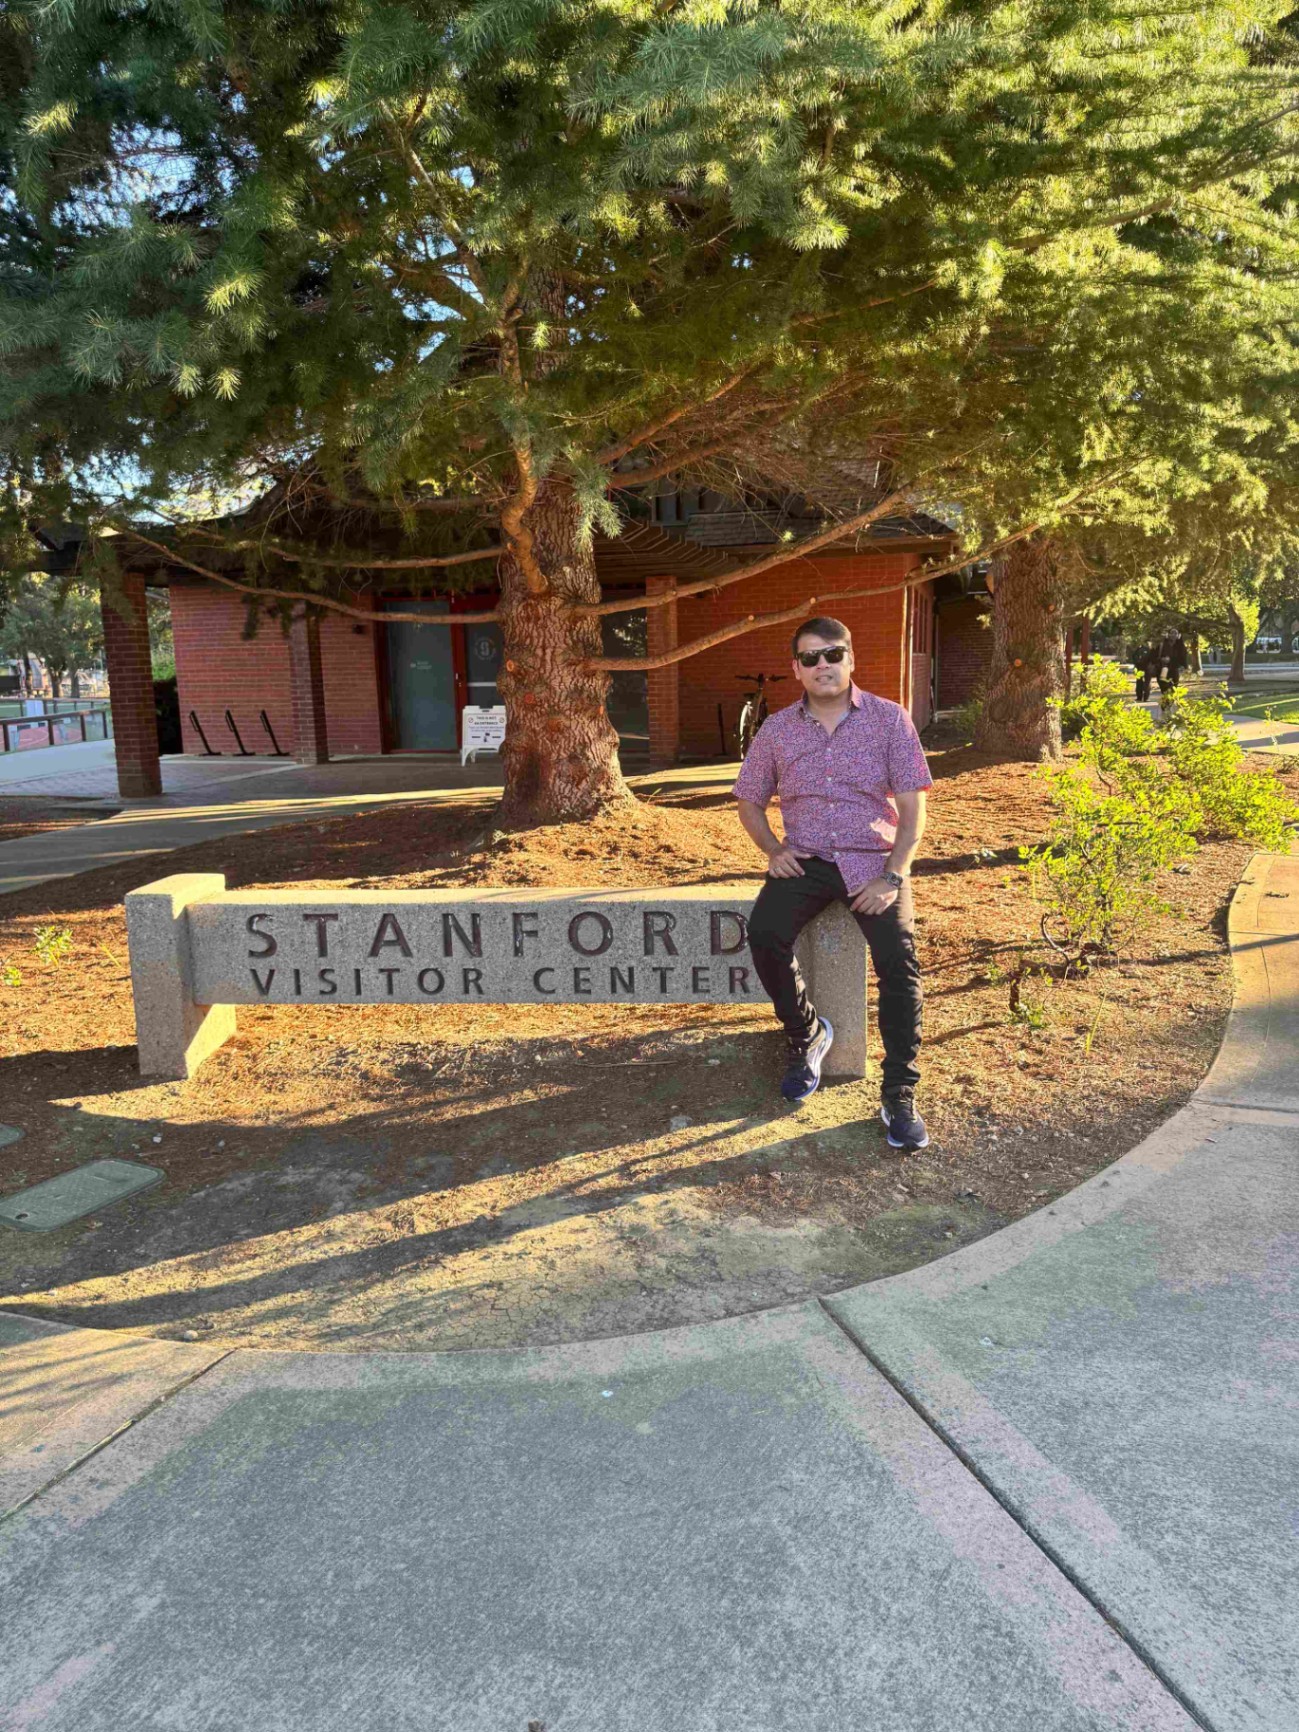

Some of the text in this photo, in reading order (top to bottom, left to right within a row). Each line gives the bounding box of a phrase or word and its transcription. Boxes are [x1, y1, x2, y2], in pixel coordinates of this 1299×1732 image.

[245, 911, 750, 958] STANFORD
[250, 966, 751, 996] VISITOR CENTER
